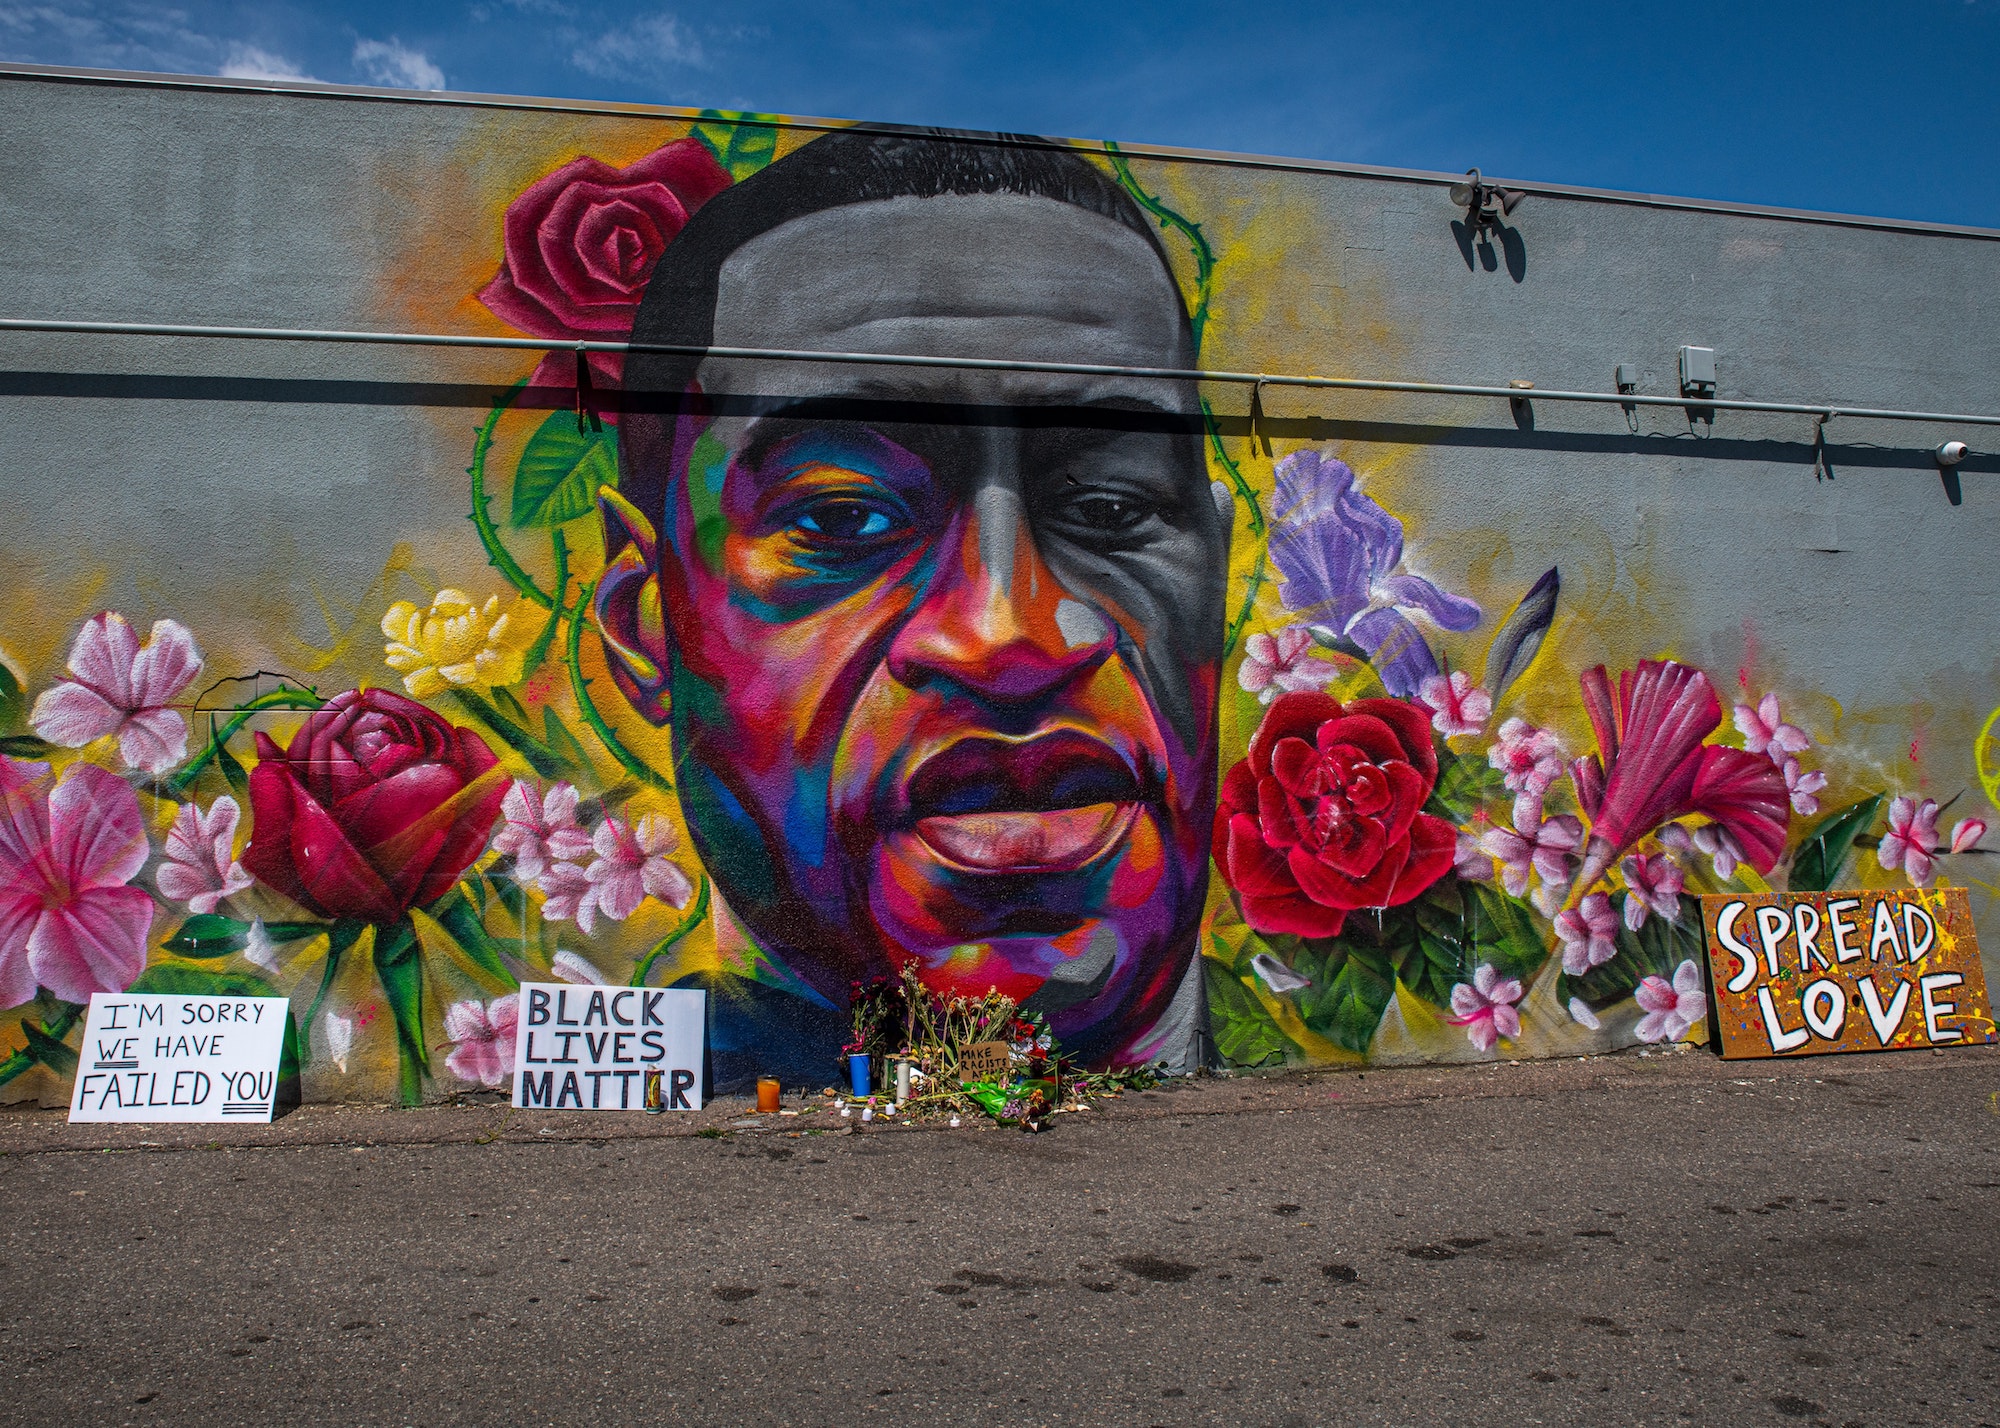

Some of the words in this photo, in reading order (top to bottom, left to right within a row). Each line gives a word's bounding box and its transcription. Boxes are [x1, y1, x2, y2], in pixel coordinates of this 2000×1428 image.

[1716, 898, 1937, 994] SPREAD
[100, 1003, 163, 1030] I'M
[181, 1003, 264, 1025] SORRY
[528, 989, 665, 1026] BLACK
[1757, 972, 1966, 1054] LOVE
[98, 1038, 139, 1061] WE
[155, 1035, 225, 1058] HAVE
[526, 1031, 666, 1063] LIVES
[961, 1047, 992, 1060] MAKE
[961, 1058, 1007, 1071] RACISTS
[79, 1071, 211, 1110] FAILED
[221, 1071, 273, 1101] YOU
